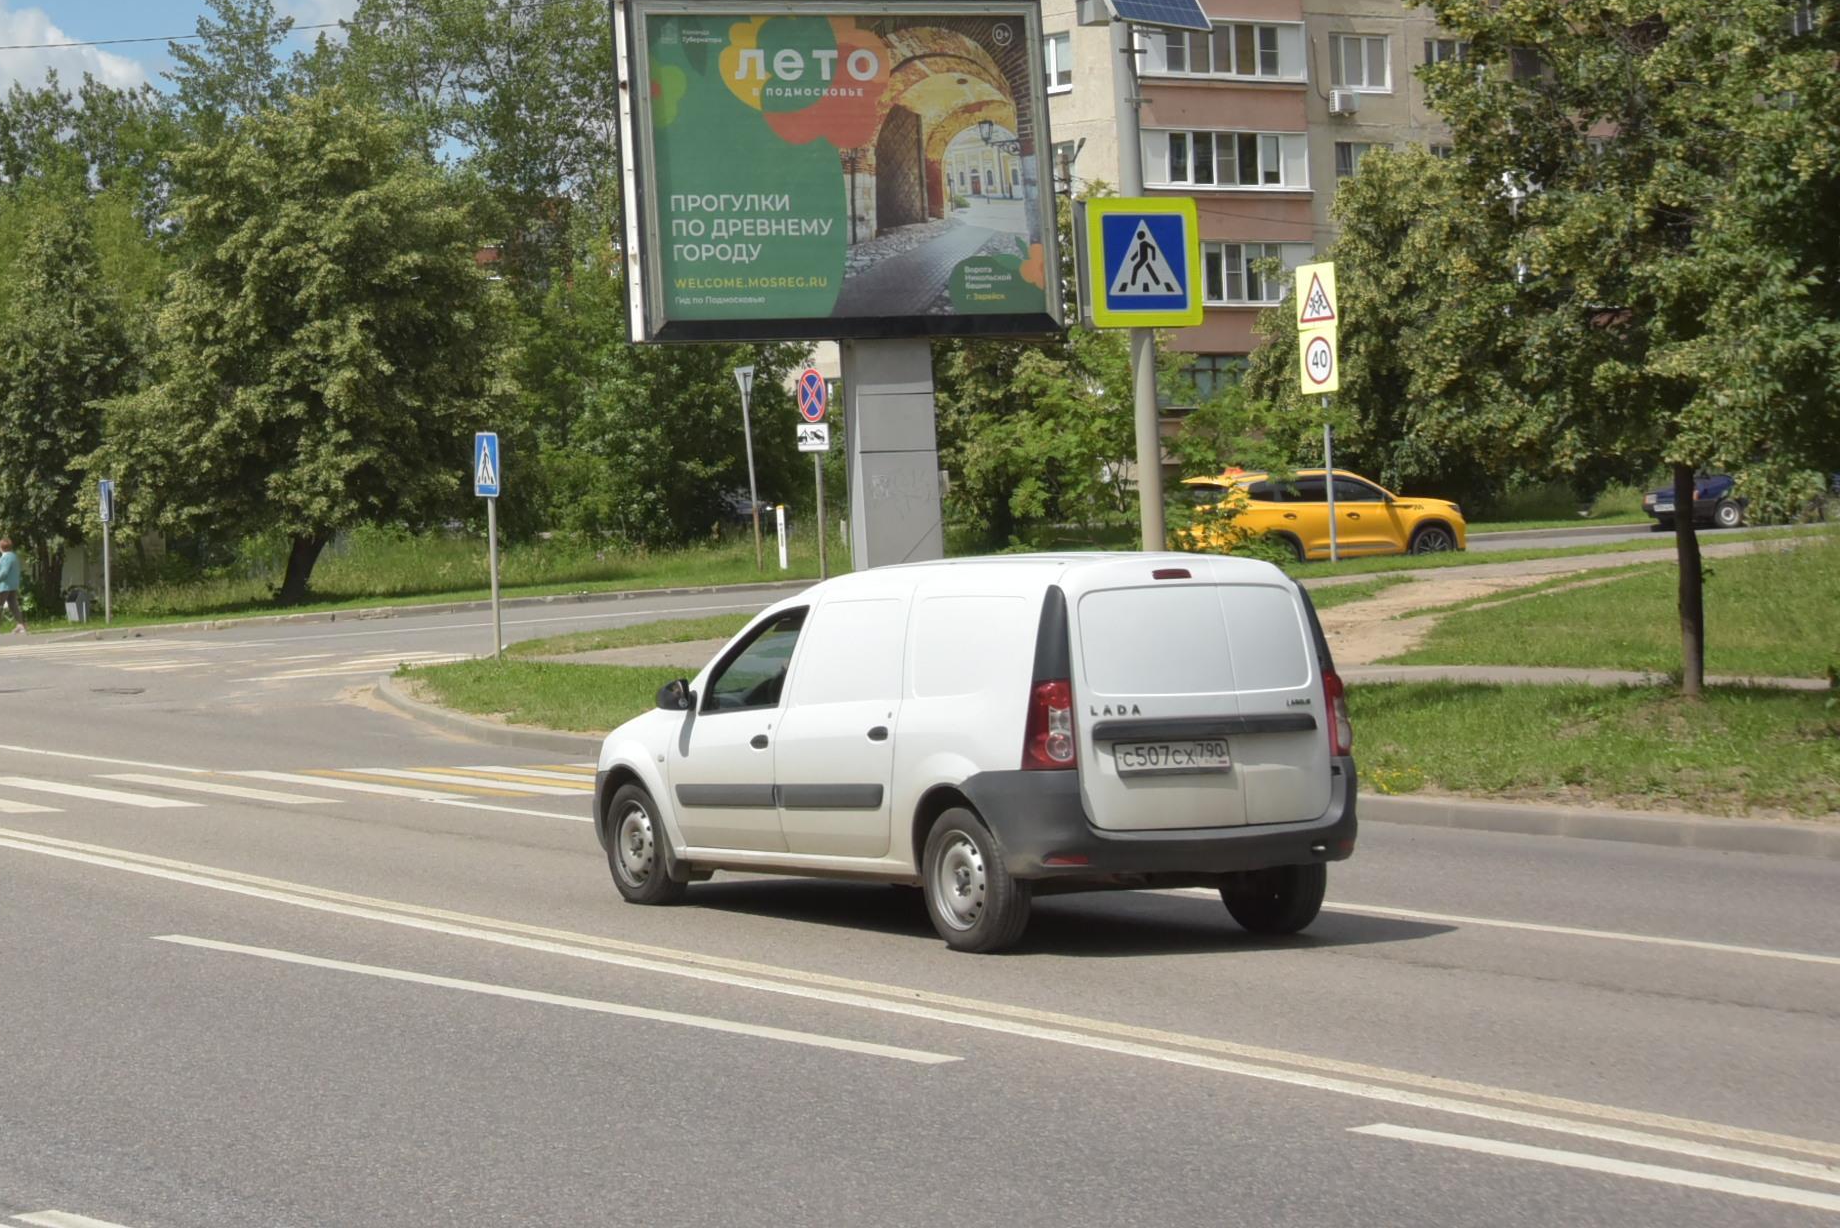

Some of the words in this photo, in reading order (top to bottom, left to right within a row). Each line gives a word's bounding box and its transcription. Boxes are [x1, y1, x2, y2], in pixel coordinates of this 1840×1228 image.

[995, 29, 1009, 40] 0+
[670, 194, 791, 212] ПРОГУЛКИ
[671, 219, 705, 237] ПО
[711, 218, 833, 240] ДРЕВНЕМУ
[673, 243, 762, 264] ГОРОДУ
[674, 276, 828, 289] WELCOME.MOSREG.RU
[1312, 349, 1328, 369] 40
[1090, 704, 1141, 717] LADA
